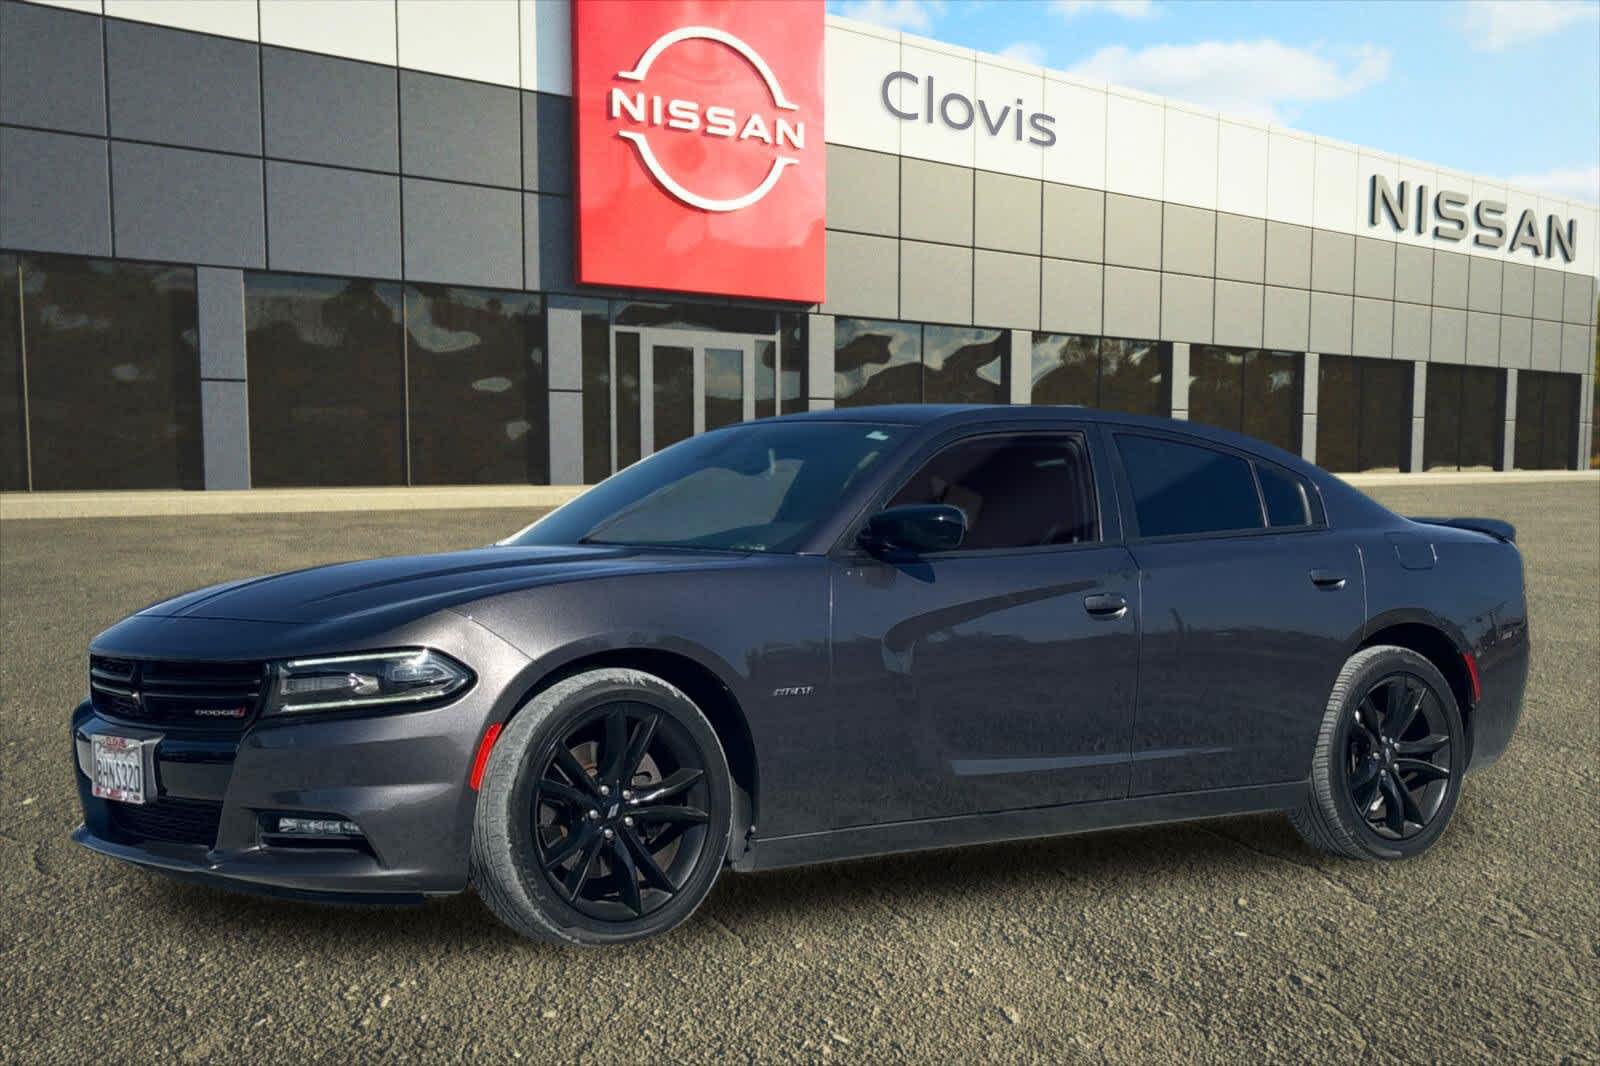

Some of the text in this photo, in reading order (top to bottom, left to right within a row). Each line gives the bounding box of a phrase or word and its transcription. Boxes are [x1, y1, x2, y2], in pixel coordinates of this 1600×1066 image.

[610, 87, 805, 149] NISSAN
[881, 71, 1057, 147] Clovis
[1369, 173, 1577, 262] NISSAN
